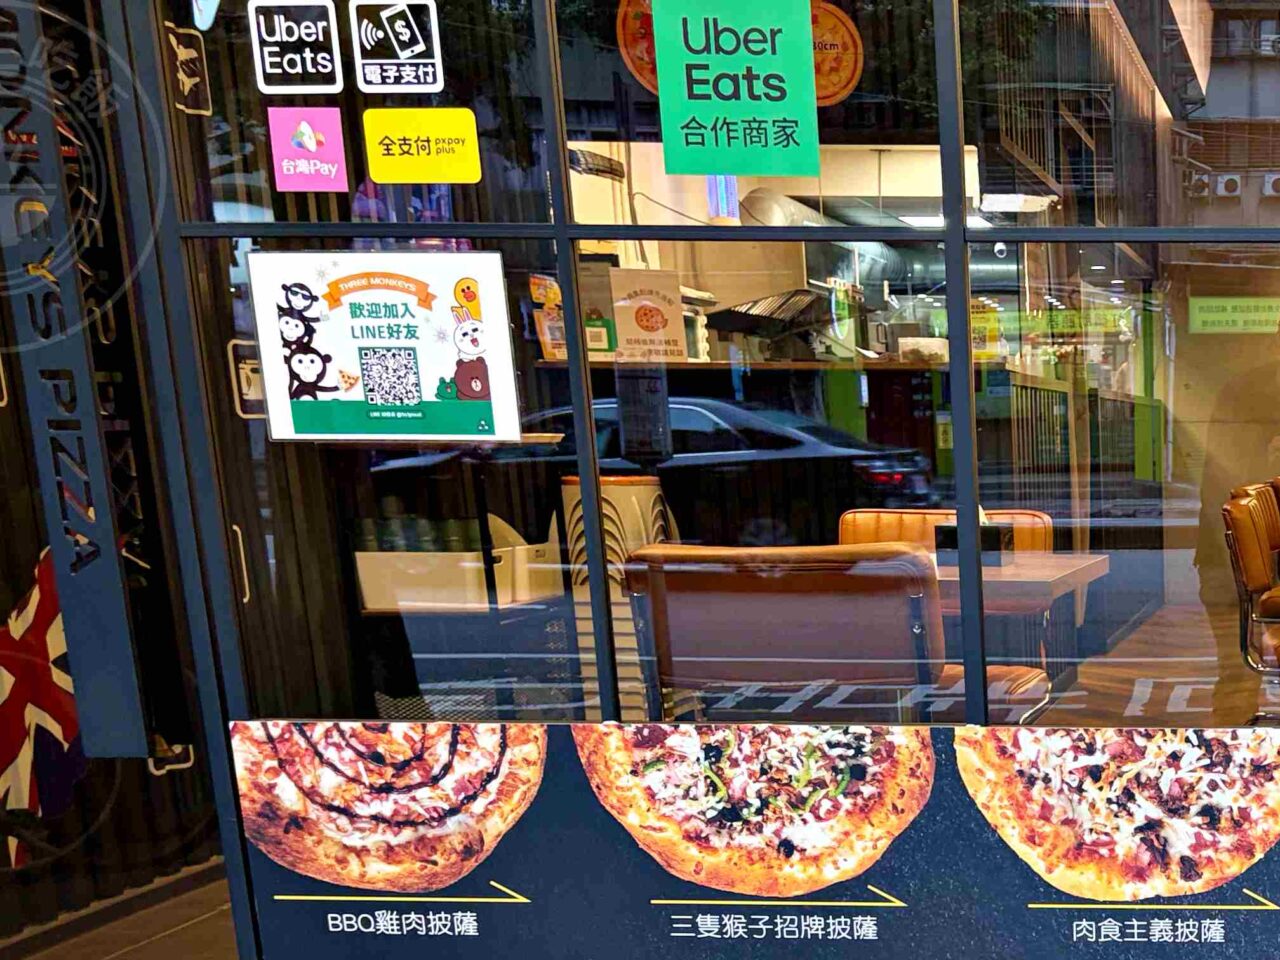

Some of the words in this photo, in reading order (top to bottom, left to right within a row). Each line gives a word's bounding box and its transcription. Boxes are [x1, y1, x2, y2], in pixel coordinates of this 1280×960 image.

[258, 14, 328, 43] Uber
[681, 16, 783, 56] Uber
[262, 46, 333, 74] Eats
[363, 65, 435, 84] 電子支付
[685, 63, 787, 103] Eats
[680, 115, 800, 149] 合作商家
[378, 135, 432, 157] 全支付
[435, 137, 466, 147] pxpay
[436, 145, 456, 155] plus
[348, 302, 416, 319] 歡迎加入
[350, 323, 420, 340] LINE好友
[38, 367, 102, 577] PIZZA
[327, 910, 480, 936] BBQ雞肉披薩
[670, 913, 879, 940] 三隻猴子招牌披薩
[1072, 917, 1226, 944] 肉食主義披薩
